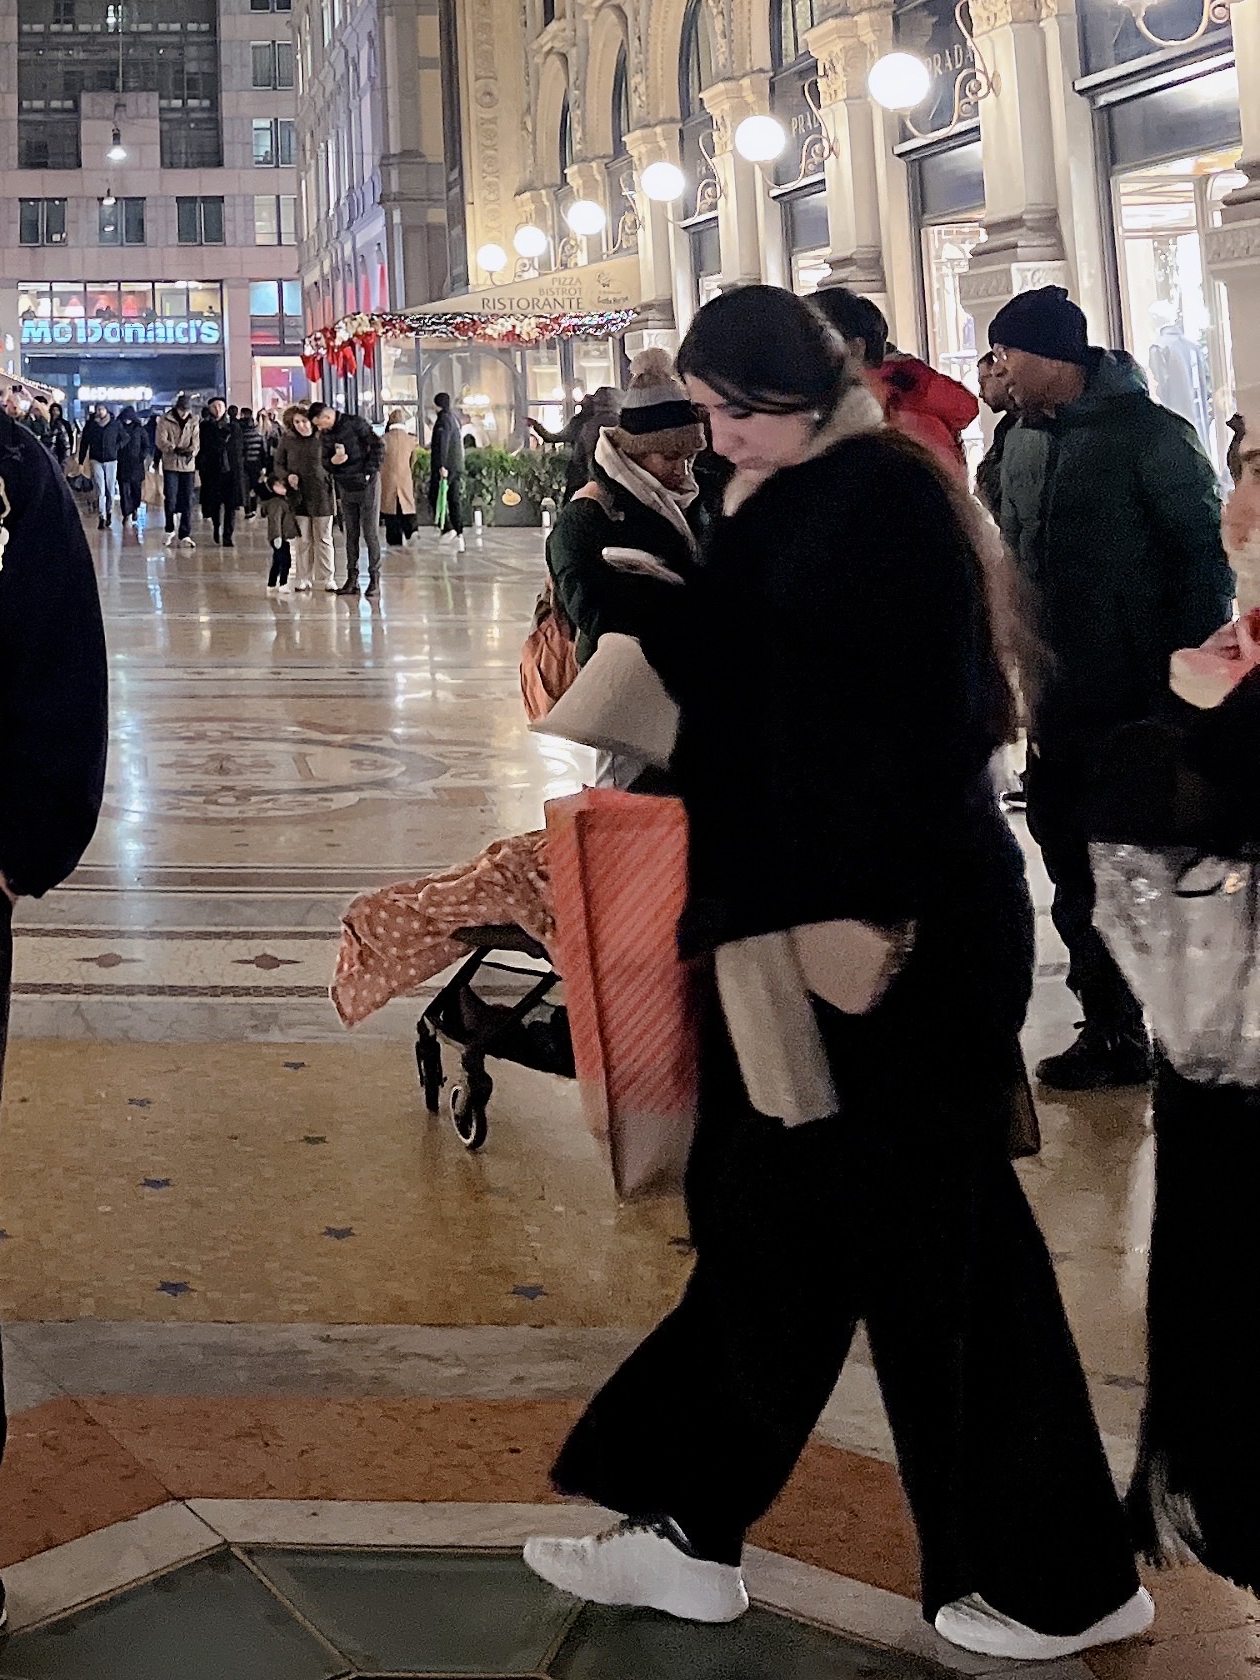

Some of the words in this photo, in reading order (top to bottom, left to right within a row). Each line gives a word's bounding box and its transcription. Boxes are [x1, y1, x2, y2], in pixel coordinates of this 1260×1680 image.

[551, 277, 582, 286] PIZZA
[539, 286, 583, 296] BISTROT
[481, 297, 585, 311] RISTORANTE
[21, 318, 221, 344] McDonald's
